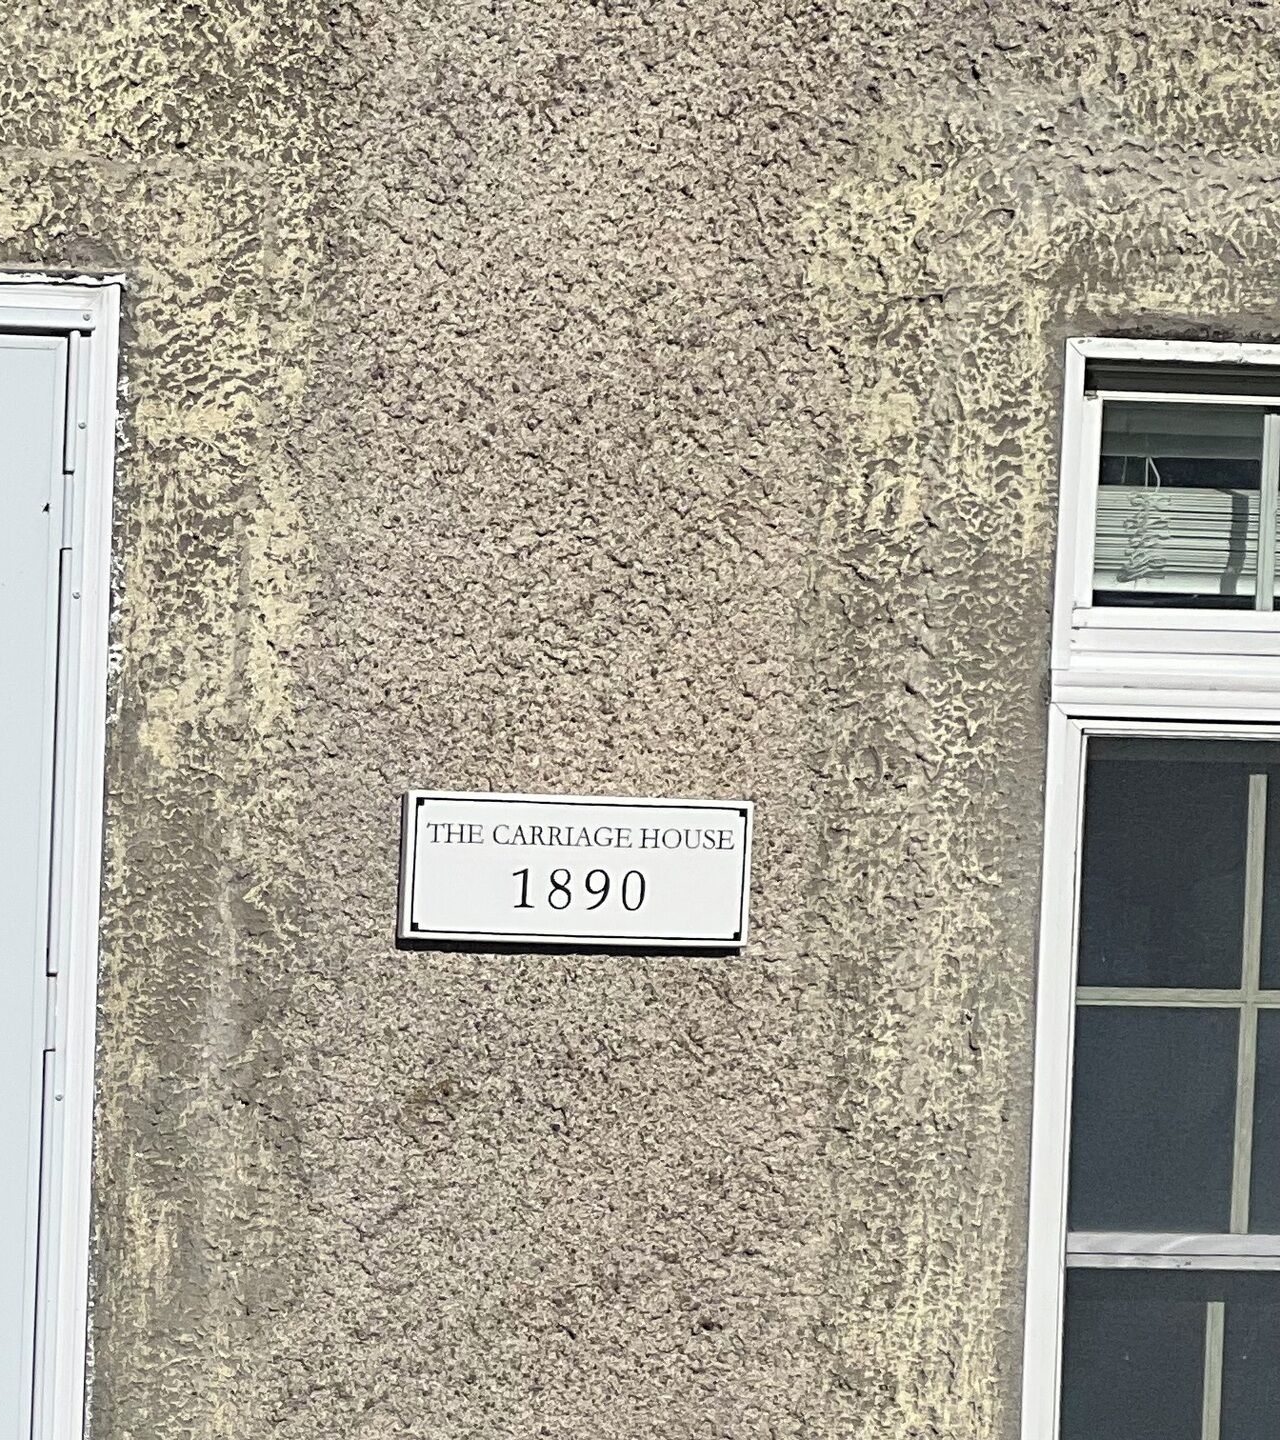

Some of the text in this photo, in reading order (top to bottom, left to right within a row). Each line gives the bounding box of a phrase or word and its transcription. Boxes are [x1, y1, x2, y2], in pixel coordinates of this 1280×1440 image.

[426, 822, 736, 851] THE CARRIAGE HOUSE
[512, 867, 647, 912] 1890
